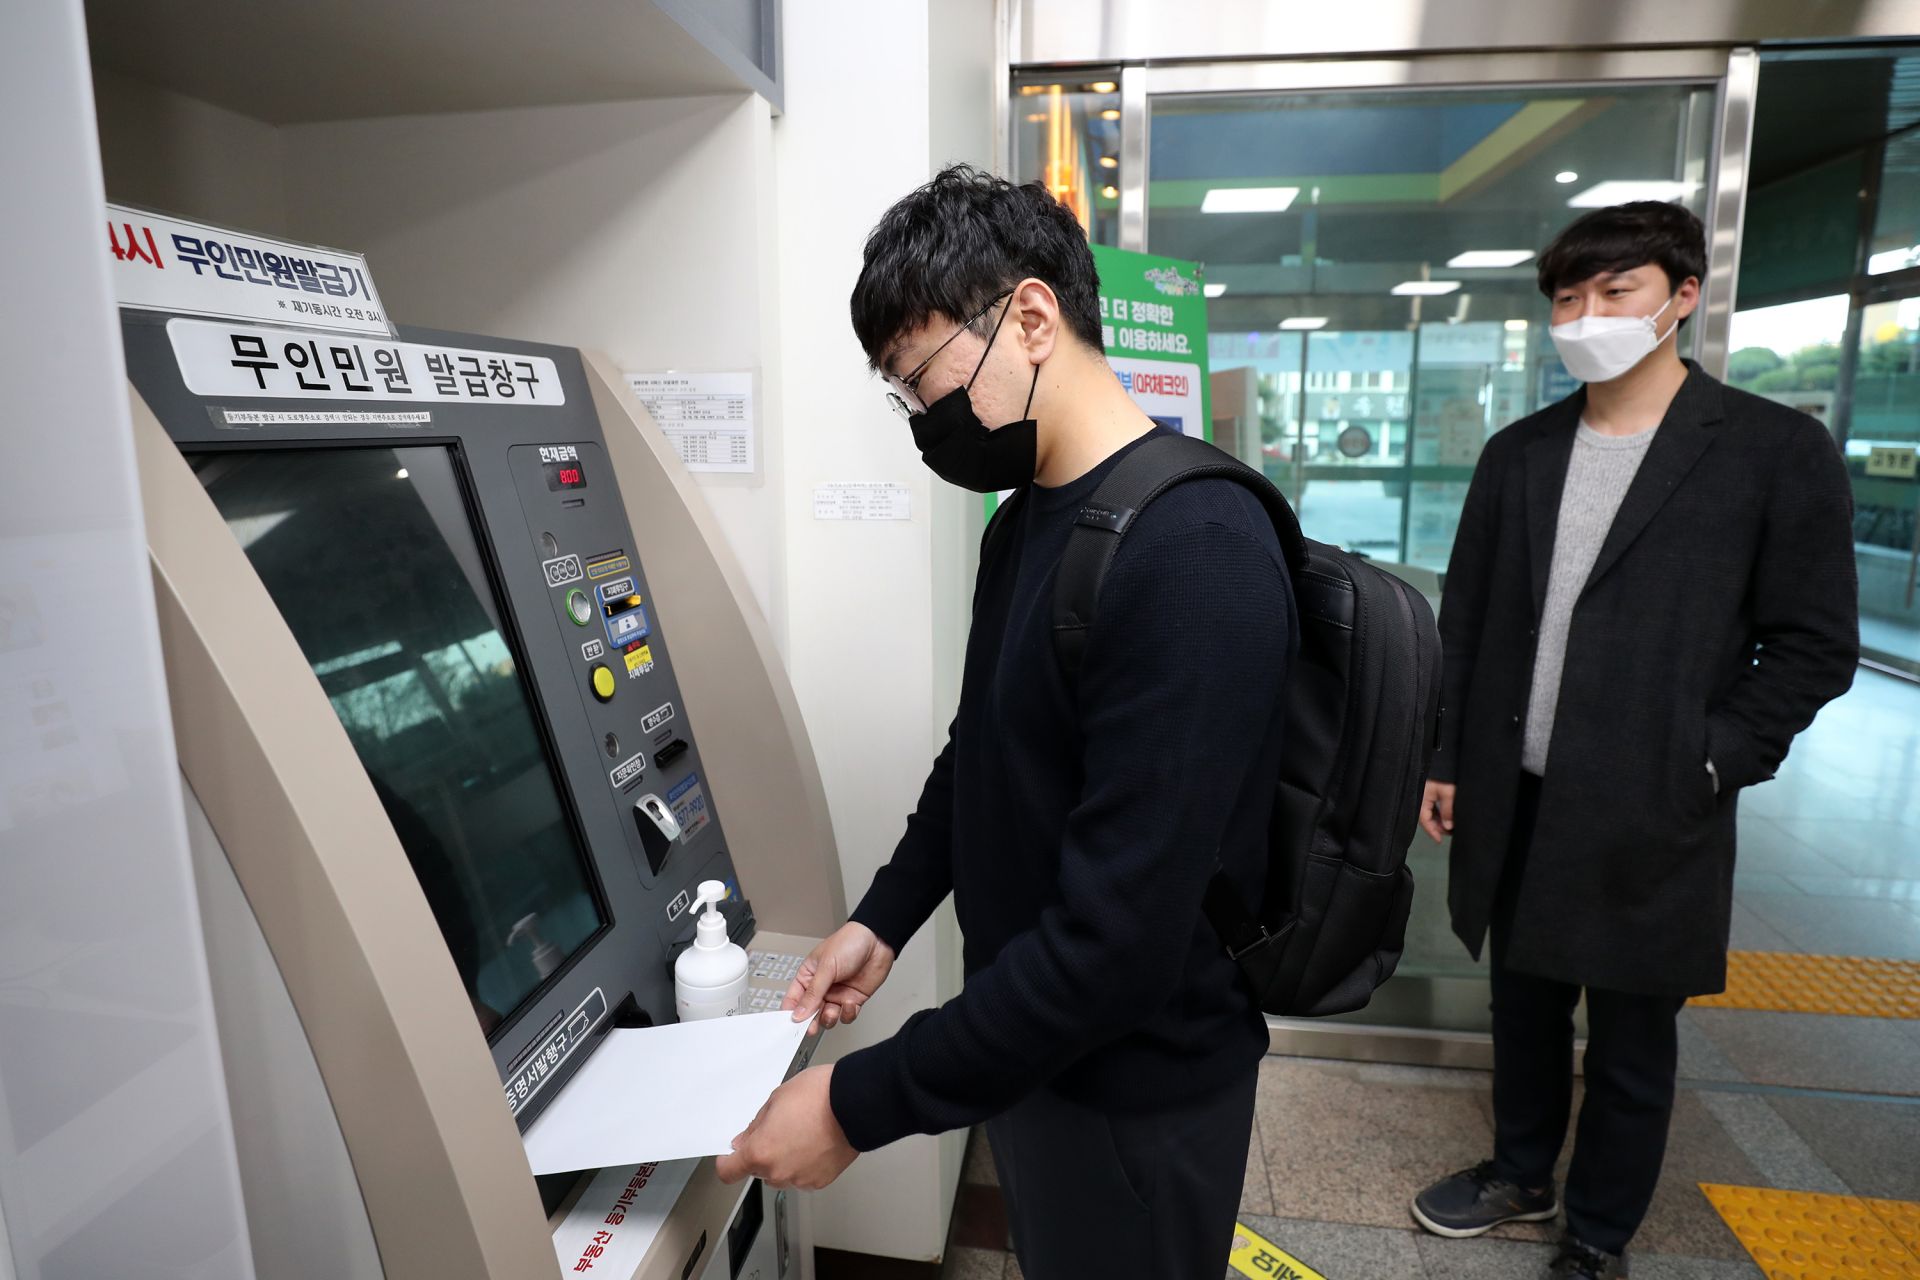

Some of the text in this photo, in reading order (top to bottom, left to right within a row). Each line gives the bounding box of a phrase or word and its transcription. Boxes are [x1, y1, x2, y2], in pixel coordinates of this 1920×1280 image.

[171, 233, 372, 302] 무인민원발급기
[291, 300, 382, 323] 재기동시간 오전 3시
[1112, 298, 1128, 321] 더
[1131, 301, 1174, 326] 정확한
[1119, 327, 1192, 354] 이용하세요.
[230, 333, 540, 400] 무인민원 발급창구
[1114, 371, 1189, 397] 부(QR체크인)
[538, 445, 578, 462] 현재금액
[573, 1230, 614, 1273] 부동산
